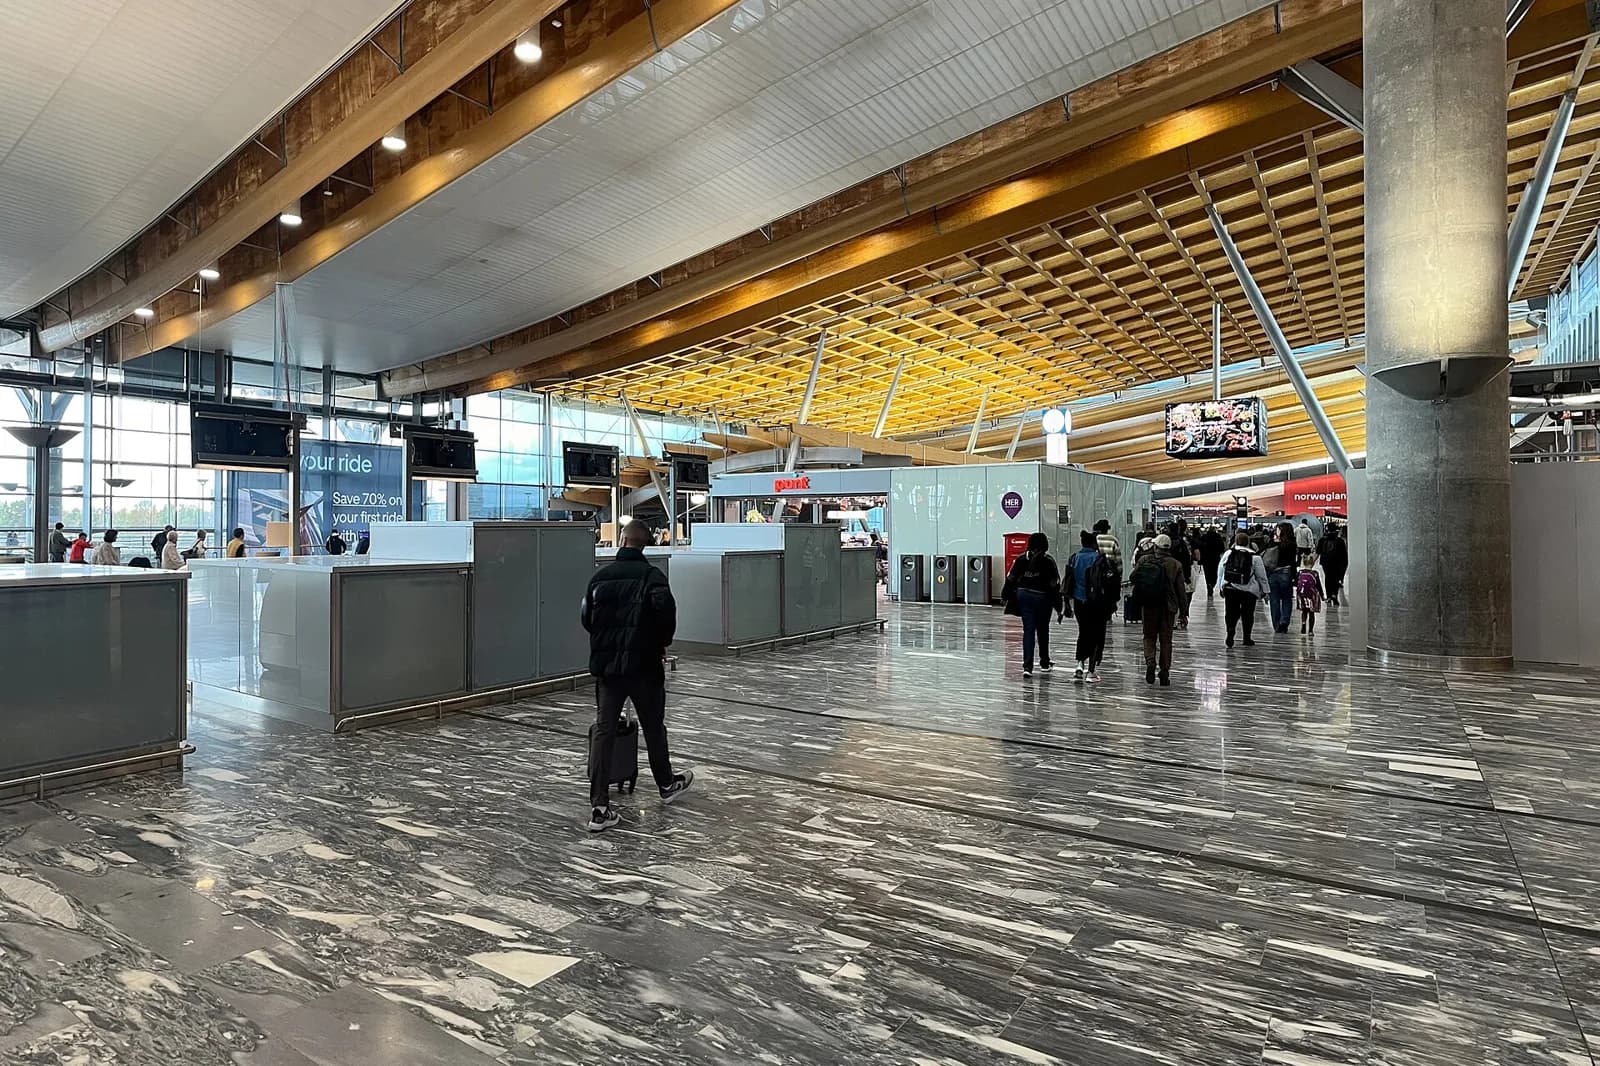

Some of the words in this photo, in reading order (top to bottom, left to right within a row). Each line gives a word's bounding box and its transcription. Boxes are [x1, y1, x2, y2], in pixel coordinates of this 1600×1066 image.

[338, 453, 373, 473] ride
[332, 491, 361, 505] Save
[362, 492, 387, 505] 70%
[388, 496, 403, 506] on
[1004, 498, 1020, 506] HER
[1294, 491, 1347, 502] norwegian
[332, 512, 358, 526] your
[360, 511, 380, 523] first
[382, 511, 404, 523] ride
[340, 529, 357, 542] ith
